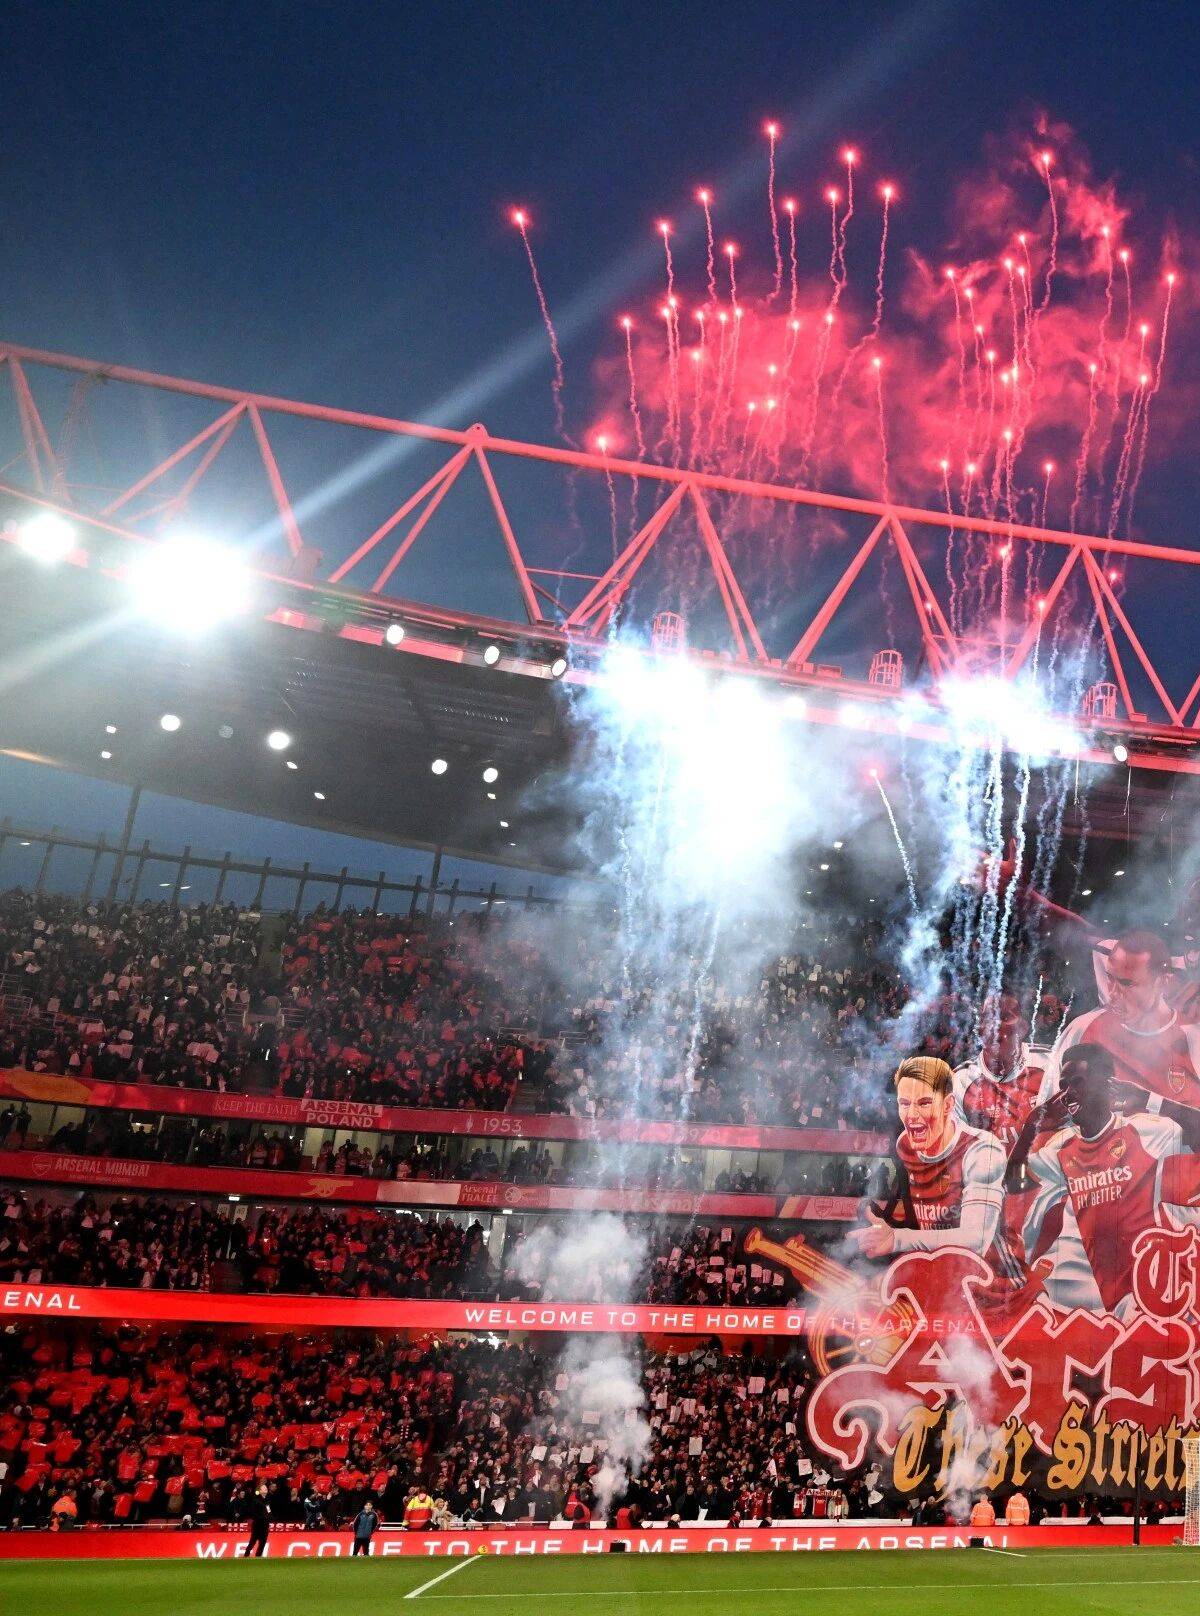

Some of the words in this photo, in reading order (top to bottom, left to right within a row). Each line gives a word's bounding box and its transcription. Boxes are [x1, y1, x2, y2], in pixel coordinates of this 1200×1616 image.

[214, 1099, 242, 1111] KEEP
[244, 1101, 265, 1113] THE
[303, 1100, 381, 1116] ARSENAL
[306, 1113, 374, 1128] POLAND
[483, 1117, 523, 1133] 1953
[55, 1157, 101, 1174] ARSENAL
[105, 1161, 151, 1178] MUMBAI
[1068, 1165, 1133, 1194] Emirates
[1091, 1184, 1122, 1206] BETTER
[4, 1291, 81, 1309] ENAL
[465, 1308, 593, 1325] WELCOME
[607, 1311, 636, 1326] TO
[650, 1312, 694, 1327] THE
[707, 1313, 775, 1328] HOME
[882, 1318, 987, 1332] ARSENA
[424, 1540, 470, 1555] TO
